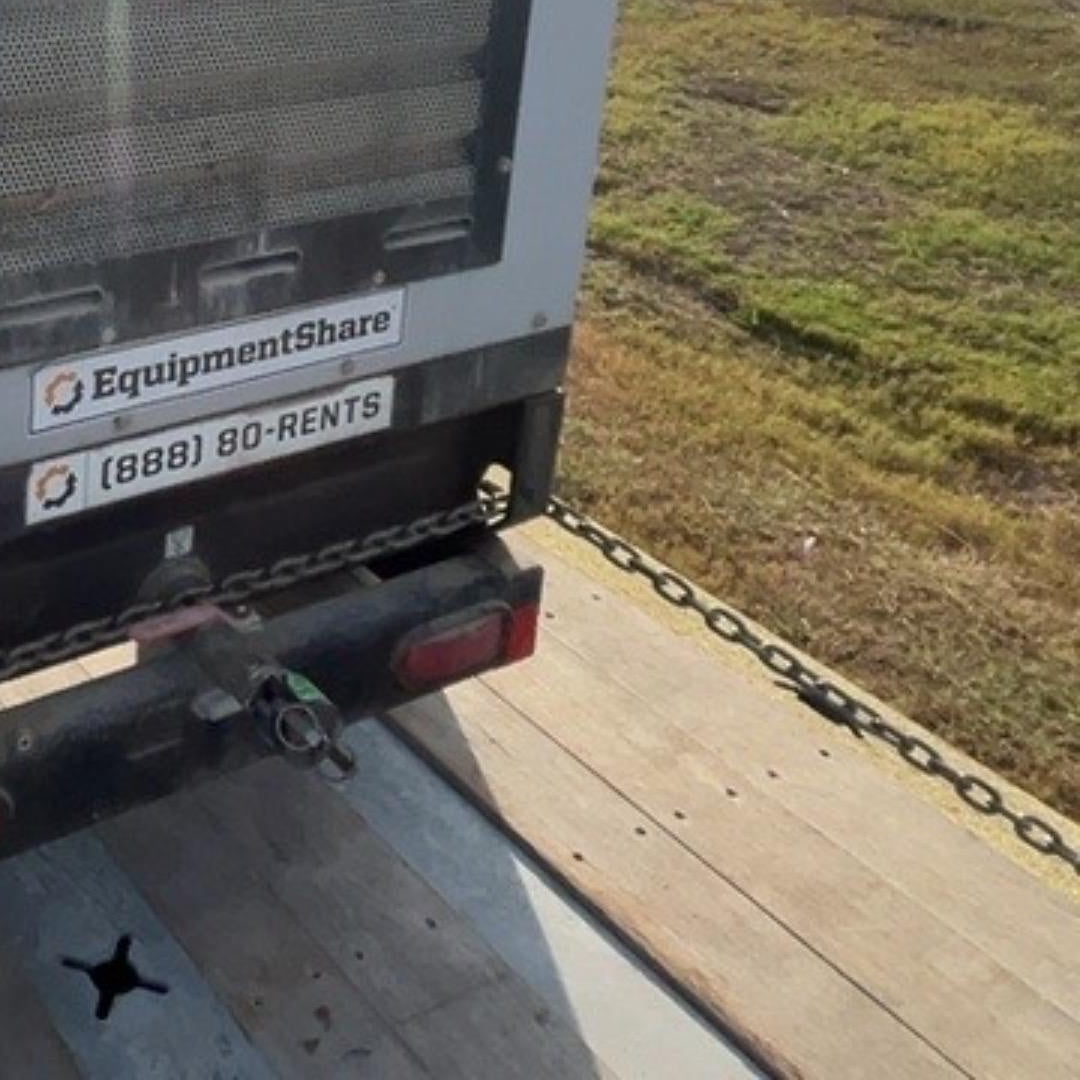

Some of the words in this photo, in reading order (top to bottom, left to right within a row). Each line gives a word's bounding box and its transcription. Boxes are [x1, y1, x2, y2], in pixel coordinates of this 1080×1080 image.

[91, 309, 391, 401] EquipmentShare
[100, 434, 202, 490] (888)
[217, 391, 381, 458] 80-RENTS
